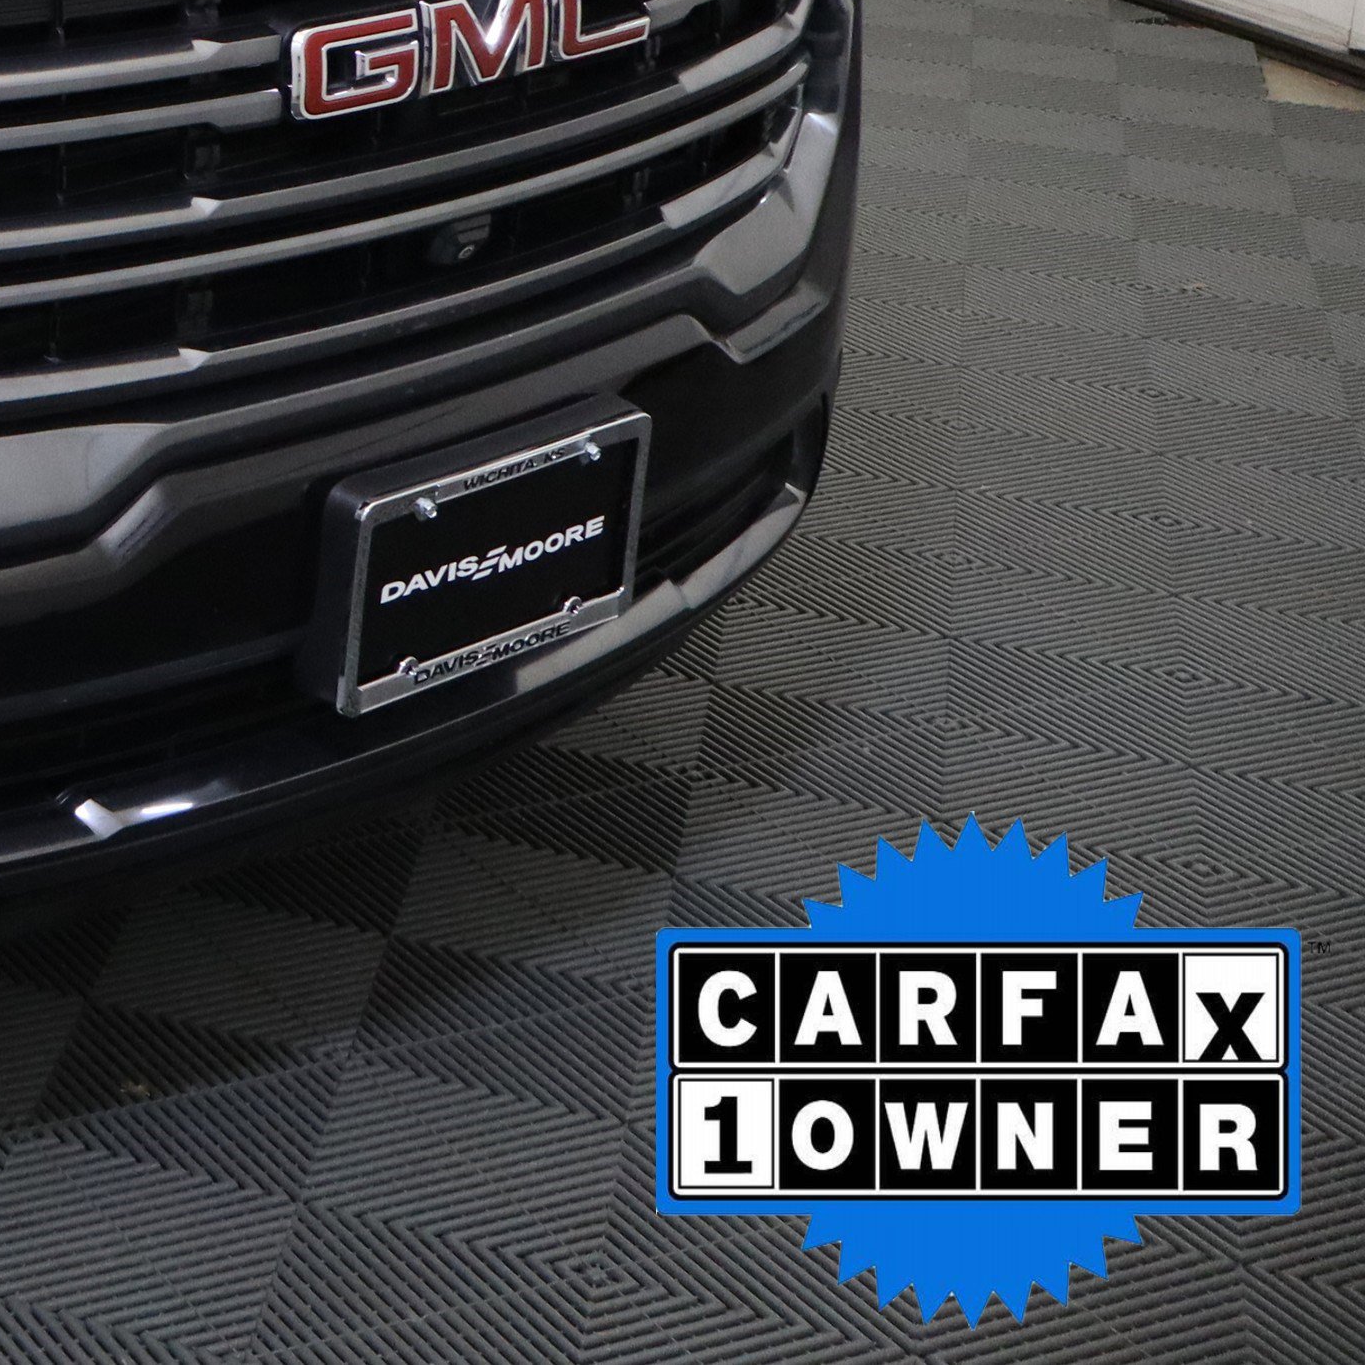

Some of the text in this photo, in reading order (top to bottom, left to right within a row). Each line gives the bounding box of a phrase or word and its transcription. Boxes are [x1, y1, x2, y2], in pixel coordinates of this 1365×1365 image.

[379, 515, 605, 605] DAVIS MOORE
[414, 621, 570, 685] DAVIS MOORE
